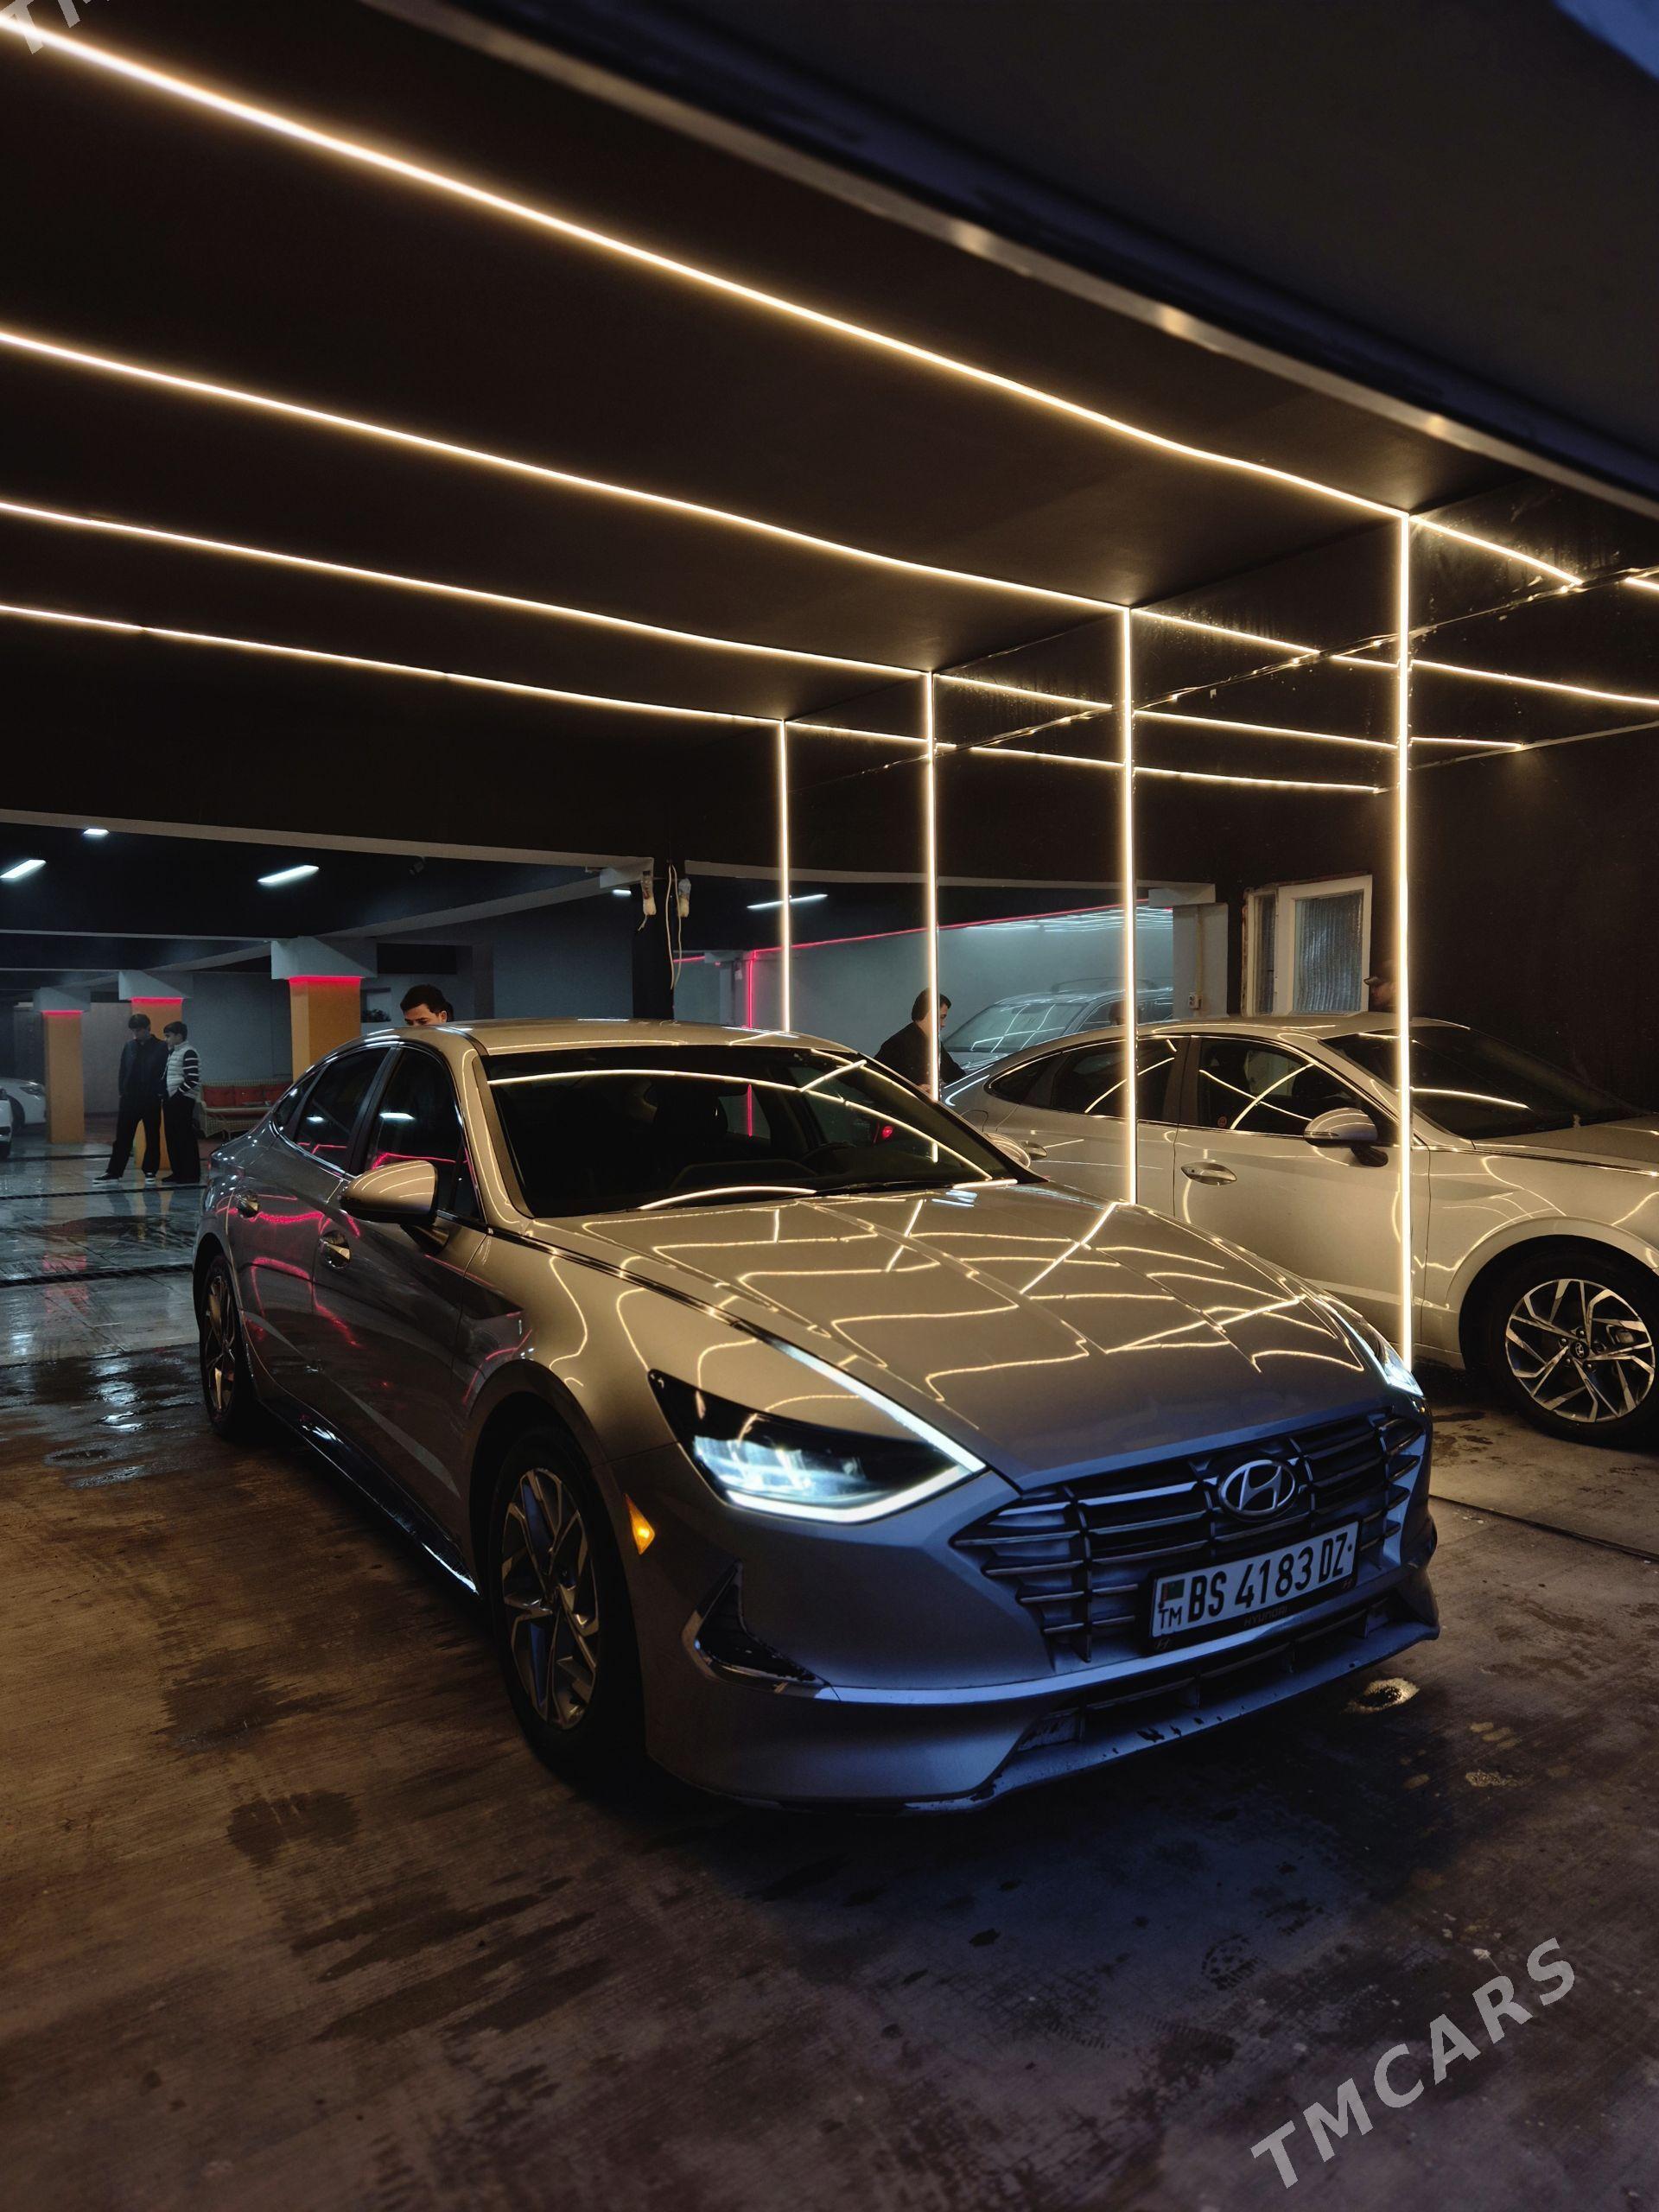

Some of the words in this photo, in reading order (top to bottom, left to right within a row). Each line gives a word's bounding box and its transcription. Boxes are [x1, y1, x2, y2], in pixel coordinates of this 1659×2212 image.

[1188, 1571, 1227, 1623] BS
[1235, 1546, 1313, 1608] 4183
[1319, 1531, 1348, 1583] DZ
[1158, 1605, 1183, 1630] TM
